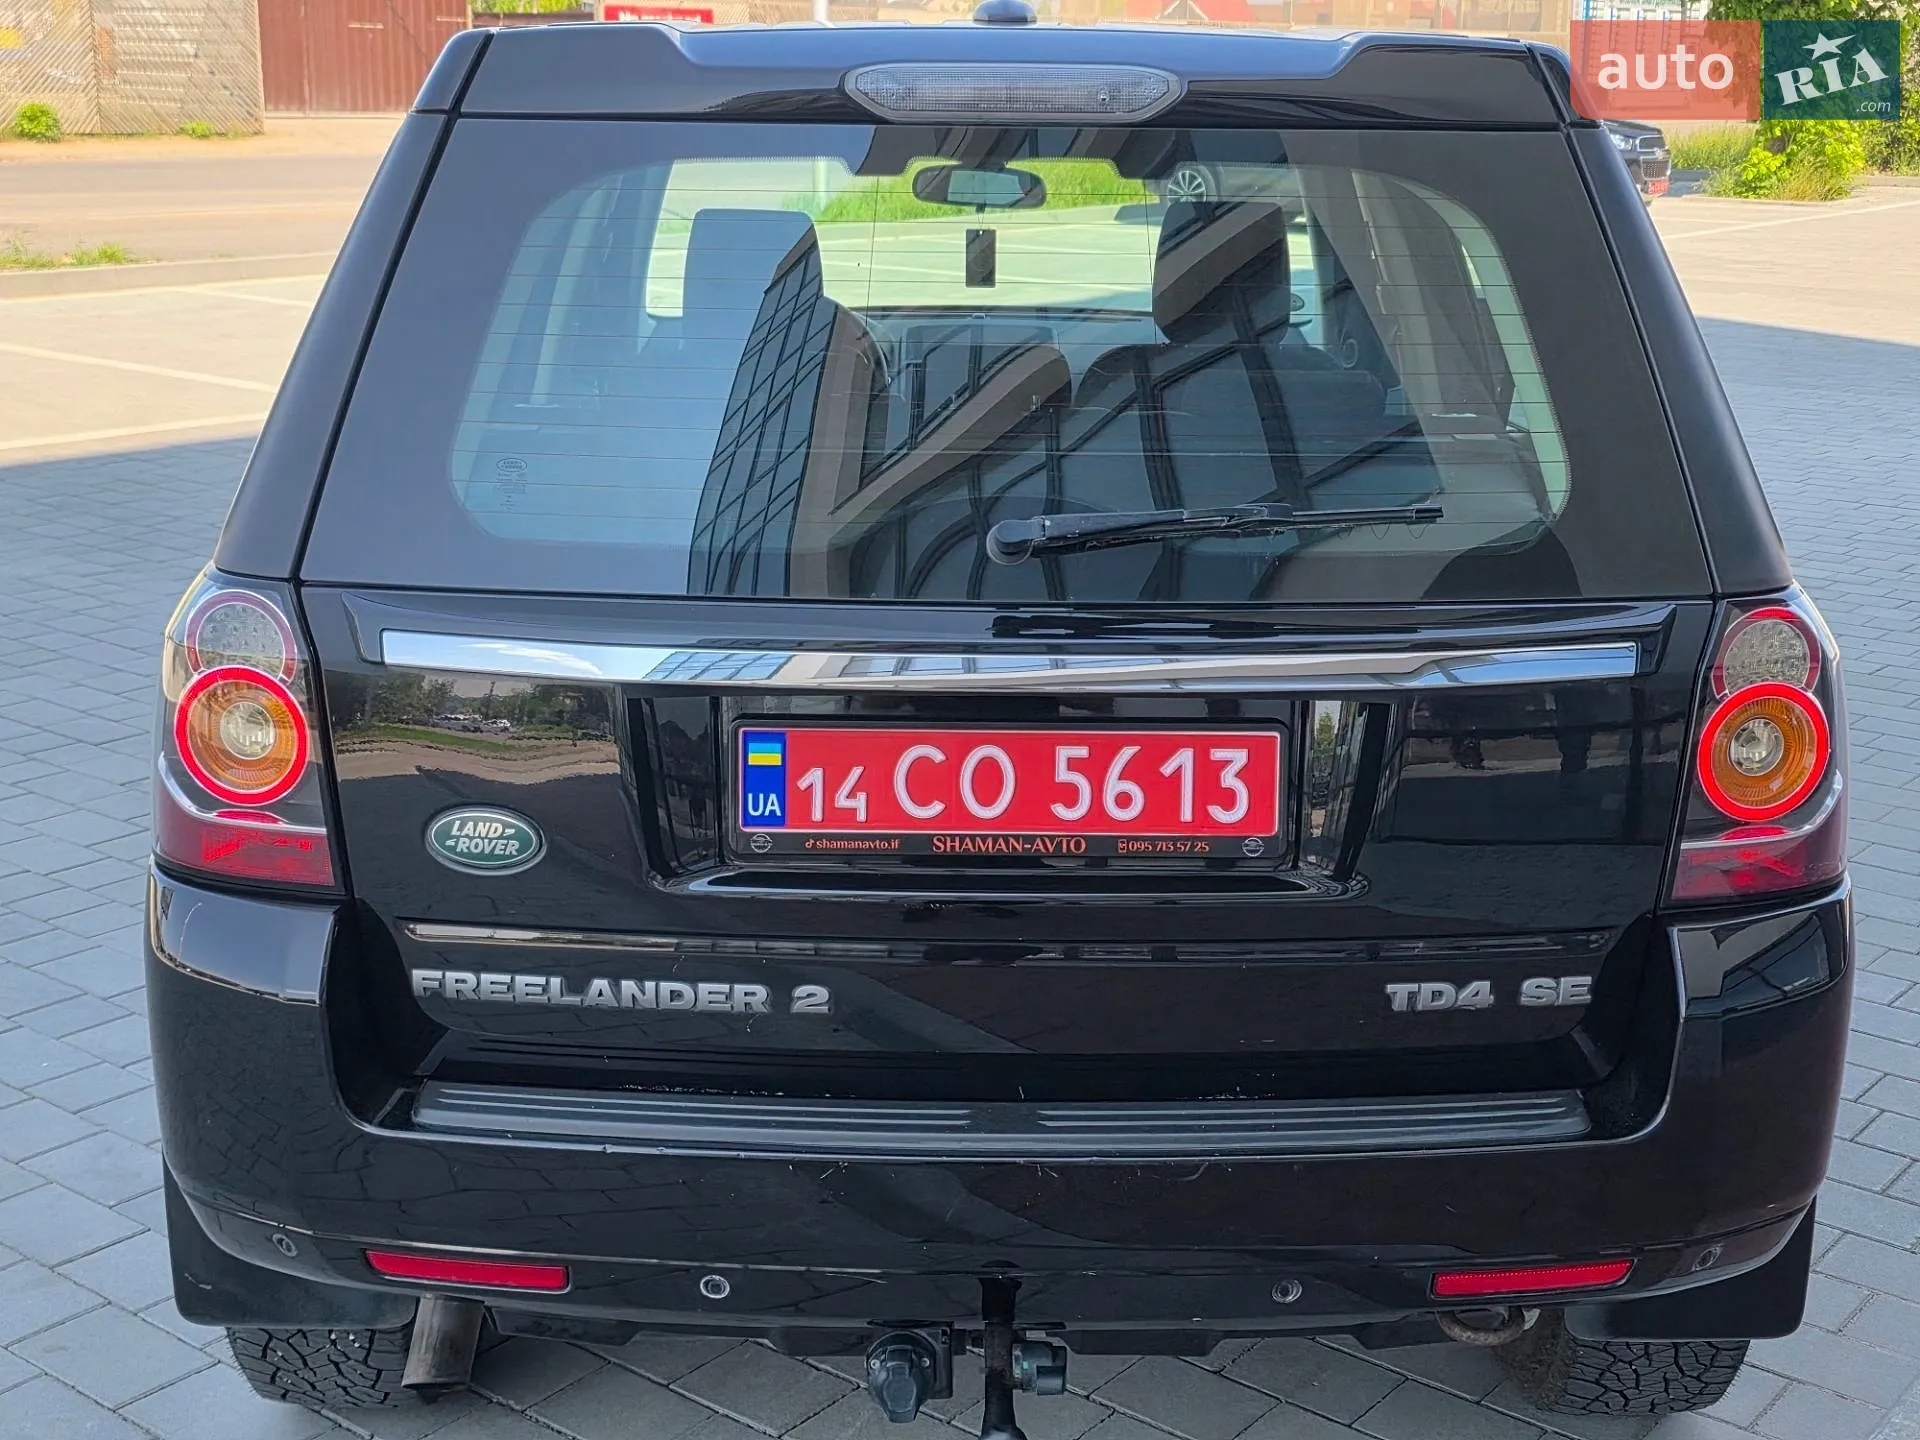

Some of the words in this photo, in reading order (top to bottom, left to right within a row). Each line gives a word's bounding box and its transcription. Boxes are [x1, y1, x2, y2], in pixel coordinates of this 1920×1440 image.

[797, 766, 867, 823] 14
[893, 744, 1016, 820] CO
[1050, 745, 1250, 824] 5613
[747, 793, 782, 816] UA
[450, 820, 503, 838] LAND
[456, 837, 520, 856] ROVER
[816, 838, 900, 849] shamanavto.if
[932, 835, 1087, 853] SHAMAN-AVTO
[1128, 840, 1152, 852] 095
[1155, 840, 1174, 852] 713
[1176, 841, 1191, 852] 57
[1194, 841, 1209, 852] 25
[412, 968, 769, 1013] FREELANDER
[791, 985, 830, 1013] 2
[1386, 980, 1494, 1012] TD4
[1520, 976, 1592, 1006] SE
